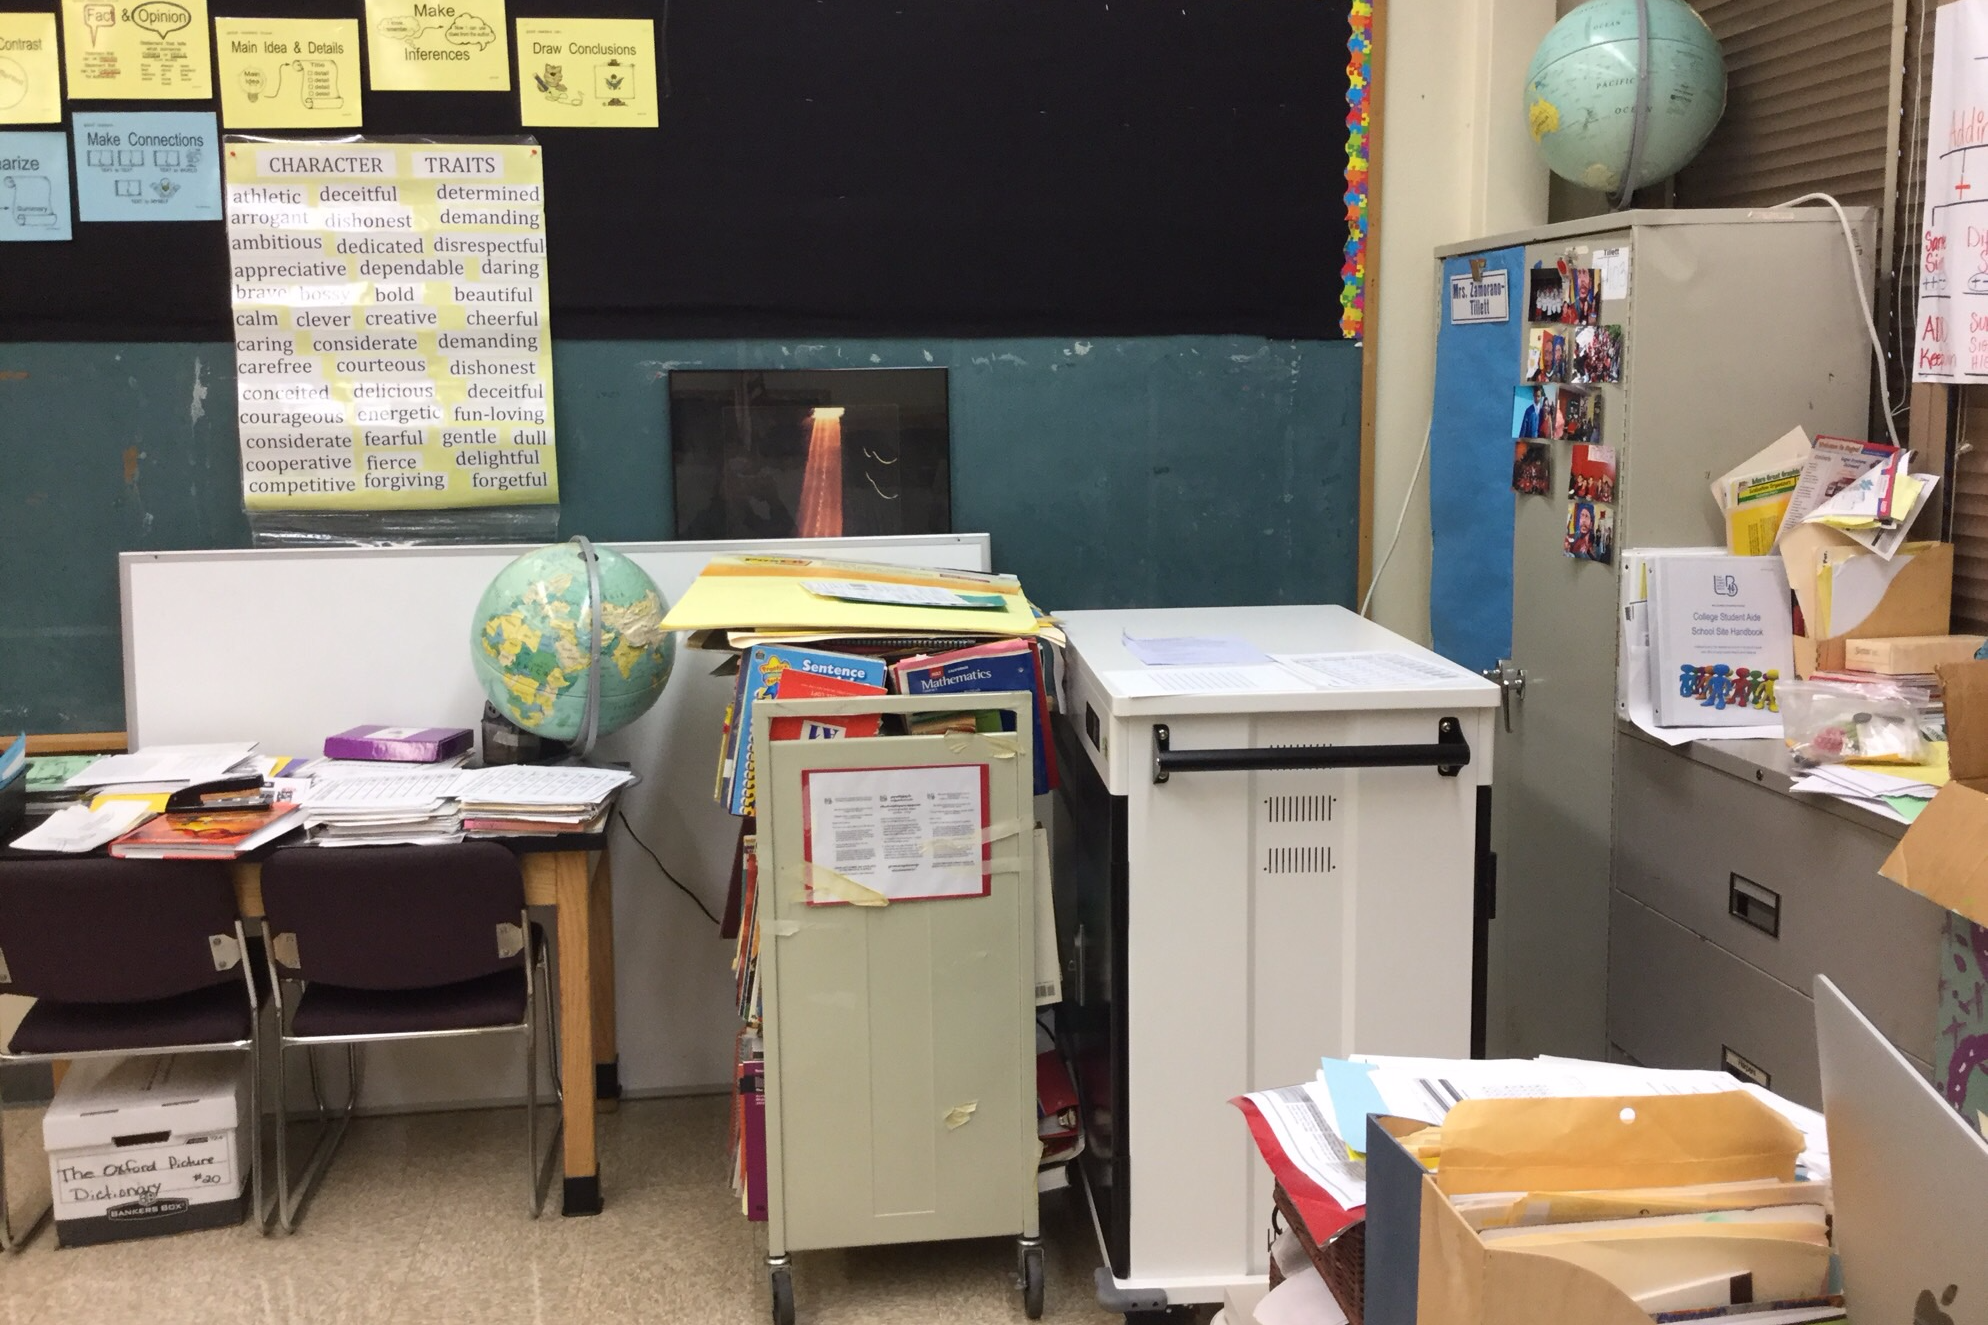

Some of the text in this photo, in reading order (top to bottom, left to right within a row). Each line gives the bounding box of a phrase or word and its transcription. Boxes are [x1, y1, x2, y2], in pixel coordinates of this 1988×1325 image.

[87, 8, 187, 26] Fact & Opinion
[413, 4, 456, 18] Make
[231, 41, 345, 54] Main Idea & Details
[404, 47, 471, 61] Inferences
[533, 42, 637, 55] Draw Conclusions
[1596, 77, 1636, 90] PACIFIC
[87, 132, 204, 147] Make Connections
[0, 155, 40, 171] arize
[269, 157, 495, 173] CHARACTER TRAITS
[233, 184, 540, 204] athletic deceitful determined
[231, 209, 540, 230] arrogant dishonest demanding
[232, 234, 545, 256] ambitious dedicated disrespectful
[234, 259, 540, 281] appreciative dependable daring
[236, 284, 287, 300] brave
[375, 286, 414, 302] bold
[454, 286, 533, 302] beautiful
[1453, 282, 1505, 299] Mrs. Zamorano-
[1470, 300, 1489, 316] Tillett
[236, 309, 539, 327] calm clever creative cheerful
[237, 333, 538, 356] caring considerate demanding
[238, 358, 536, 375] carefree courteous dishonest
[242, 383, 543, 401] conceited delicious deceitful
[240, 405, 545, 427] courageous energetic fun-loving
[246, 429, 547, 449] considerate fearful gentle dull
[246, 450, 540, 475] cooperative fierce delightful
[249, 472, 548, 496] competitive forgiving forgetful
[1693, 612, 1761, 622] College Student Aide
[1691, 627, 1764, 636] School Site Handbook
[802, 659, 866, 678] Sentence
[921, 669, 992, 690] Mathematics
[58, 1155, 214, 1182] The Oxford Picture
[193, 1173, 221, 1184] #20
[70, 1182, 161, 1201] Dictionary
[110, 1203, 183, 1217] BANKERS BOX
